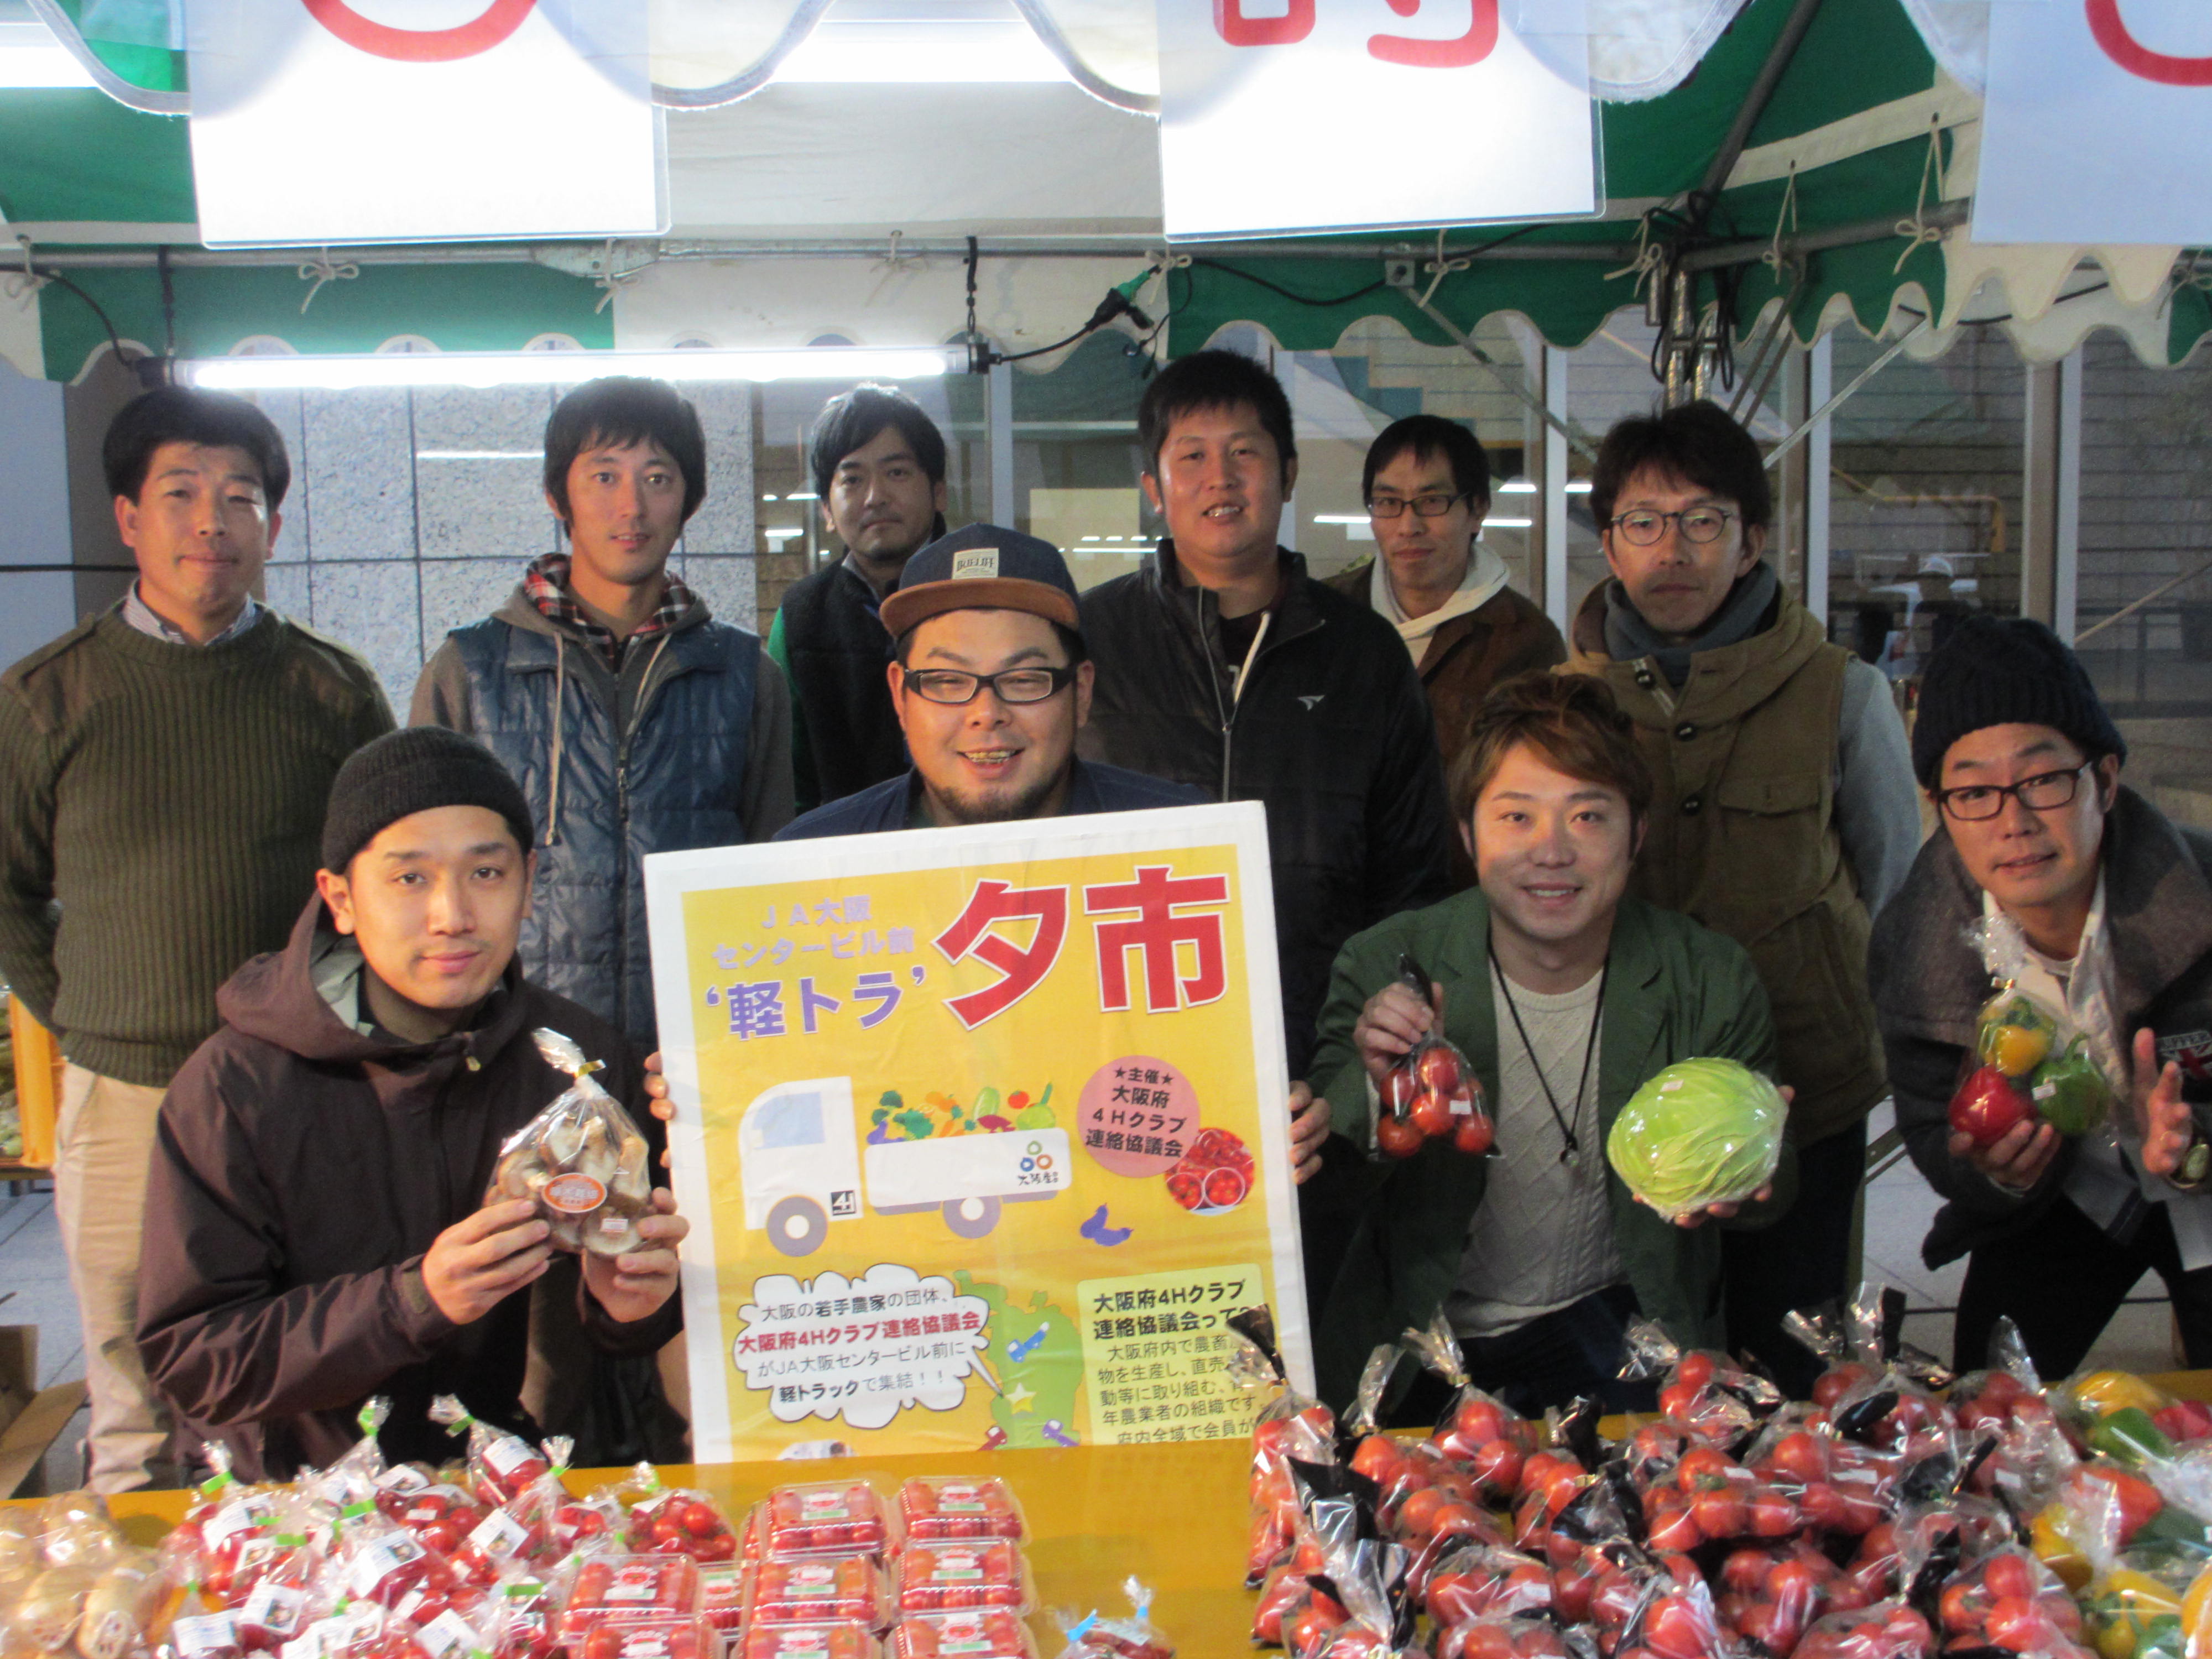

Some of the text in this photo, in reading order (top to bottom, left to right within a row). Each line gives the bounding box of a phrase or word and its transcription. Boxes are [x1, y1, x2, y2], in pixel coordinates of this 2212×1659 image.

[712, 926, 915, 970] センタービル前
[931, 864, 1230, 1032] 夕市
[1112, 1084, 1171, 1109] 大阪府
[1085, 1128, 1184, 1158] 連絡協議会
[1093, 1278, 1247, 1314] 大阪府4Hクラブ
[738, 1311, 981, 1354] 大阪府4Hクラブ連絡協議会
[1093, 1305, 1250, 1340] 連絡協議会って
[758, 1341, 967, 1378] がJA大阪センタービル前に
[1107, 1334, 1240, 1363] 大阪府内で農畜
[1098, 1355, 1230, 1385] 物を生産し、直売
